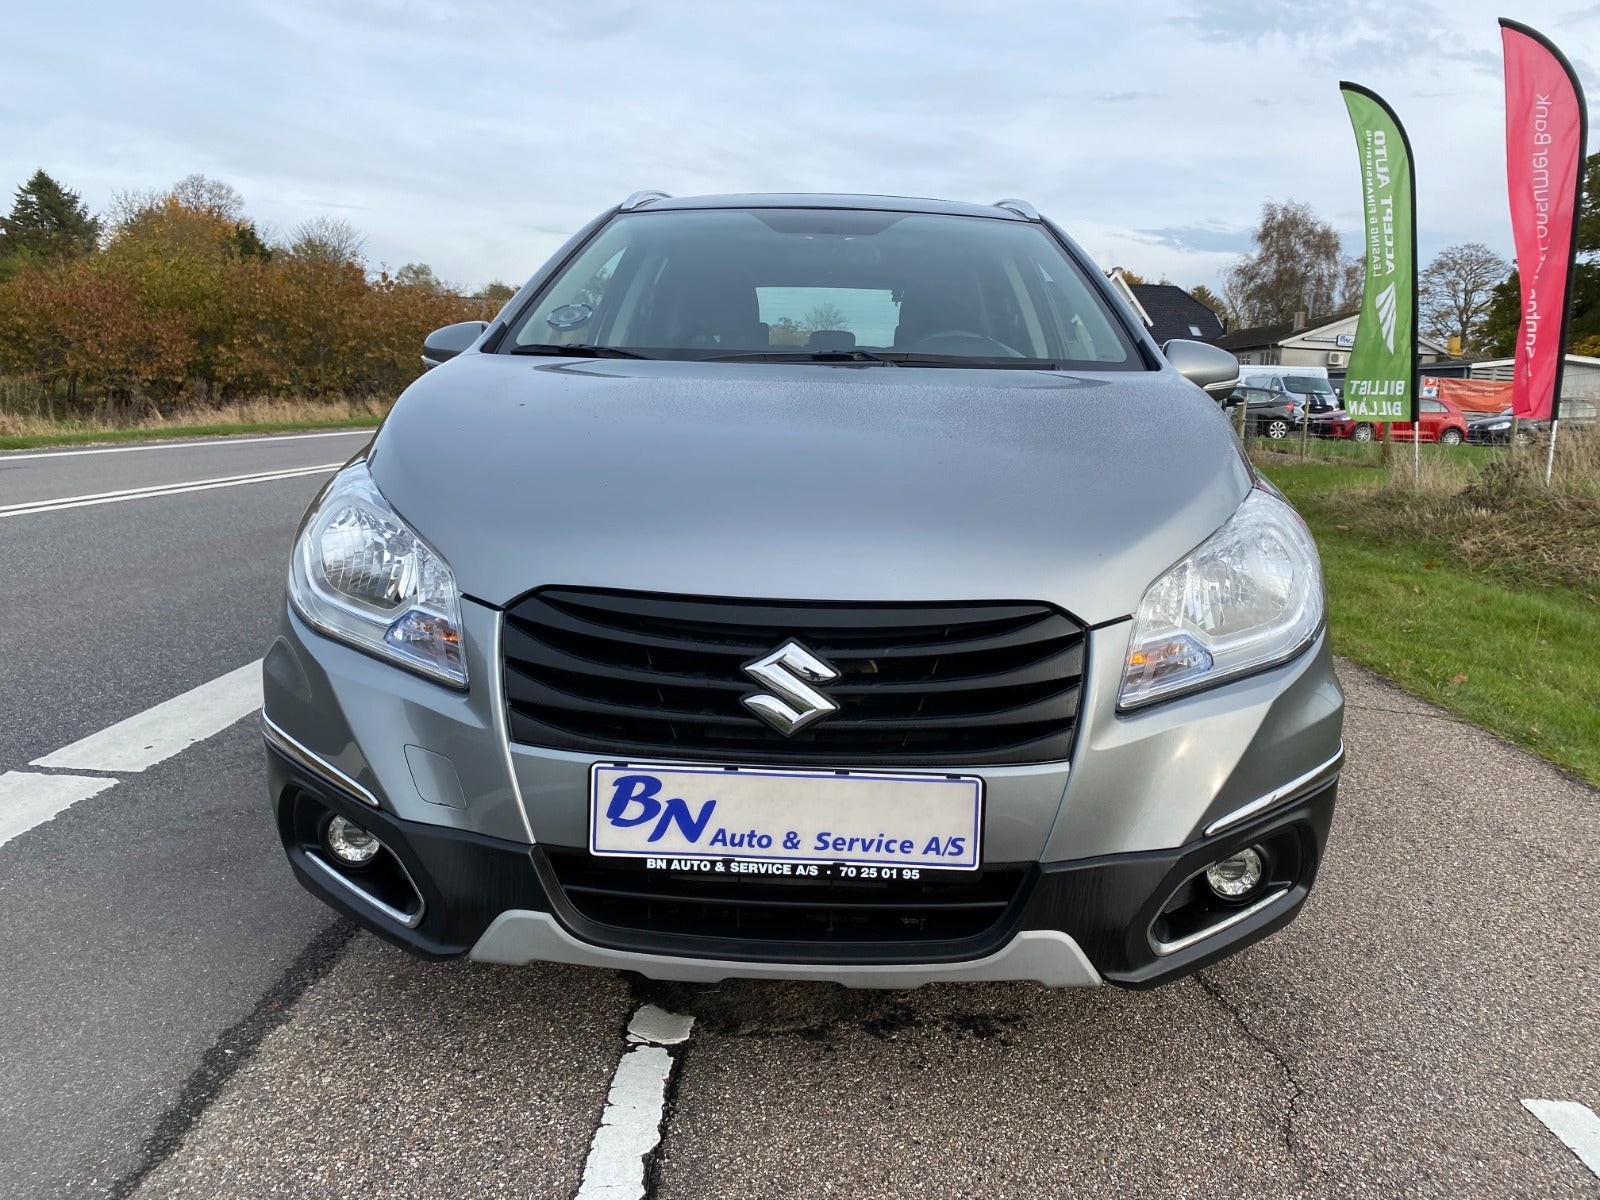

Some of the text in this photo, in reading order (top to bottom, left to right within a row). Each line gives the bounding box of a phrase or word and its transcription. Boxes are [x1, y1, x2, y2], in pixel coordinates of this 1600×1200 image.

[606, 775, 966, 857] BN Auto & Service A/S
[646, 858, 920, 880] BN AUTO & SERVICE A/S 70 25 01 95
